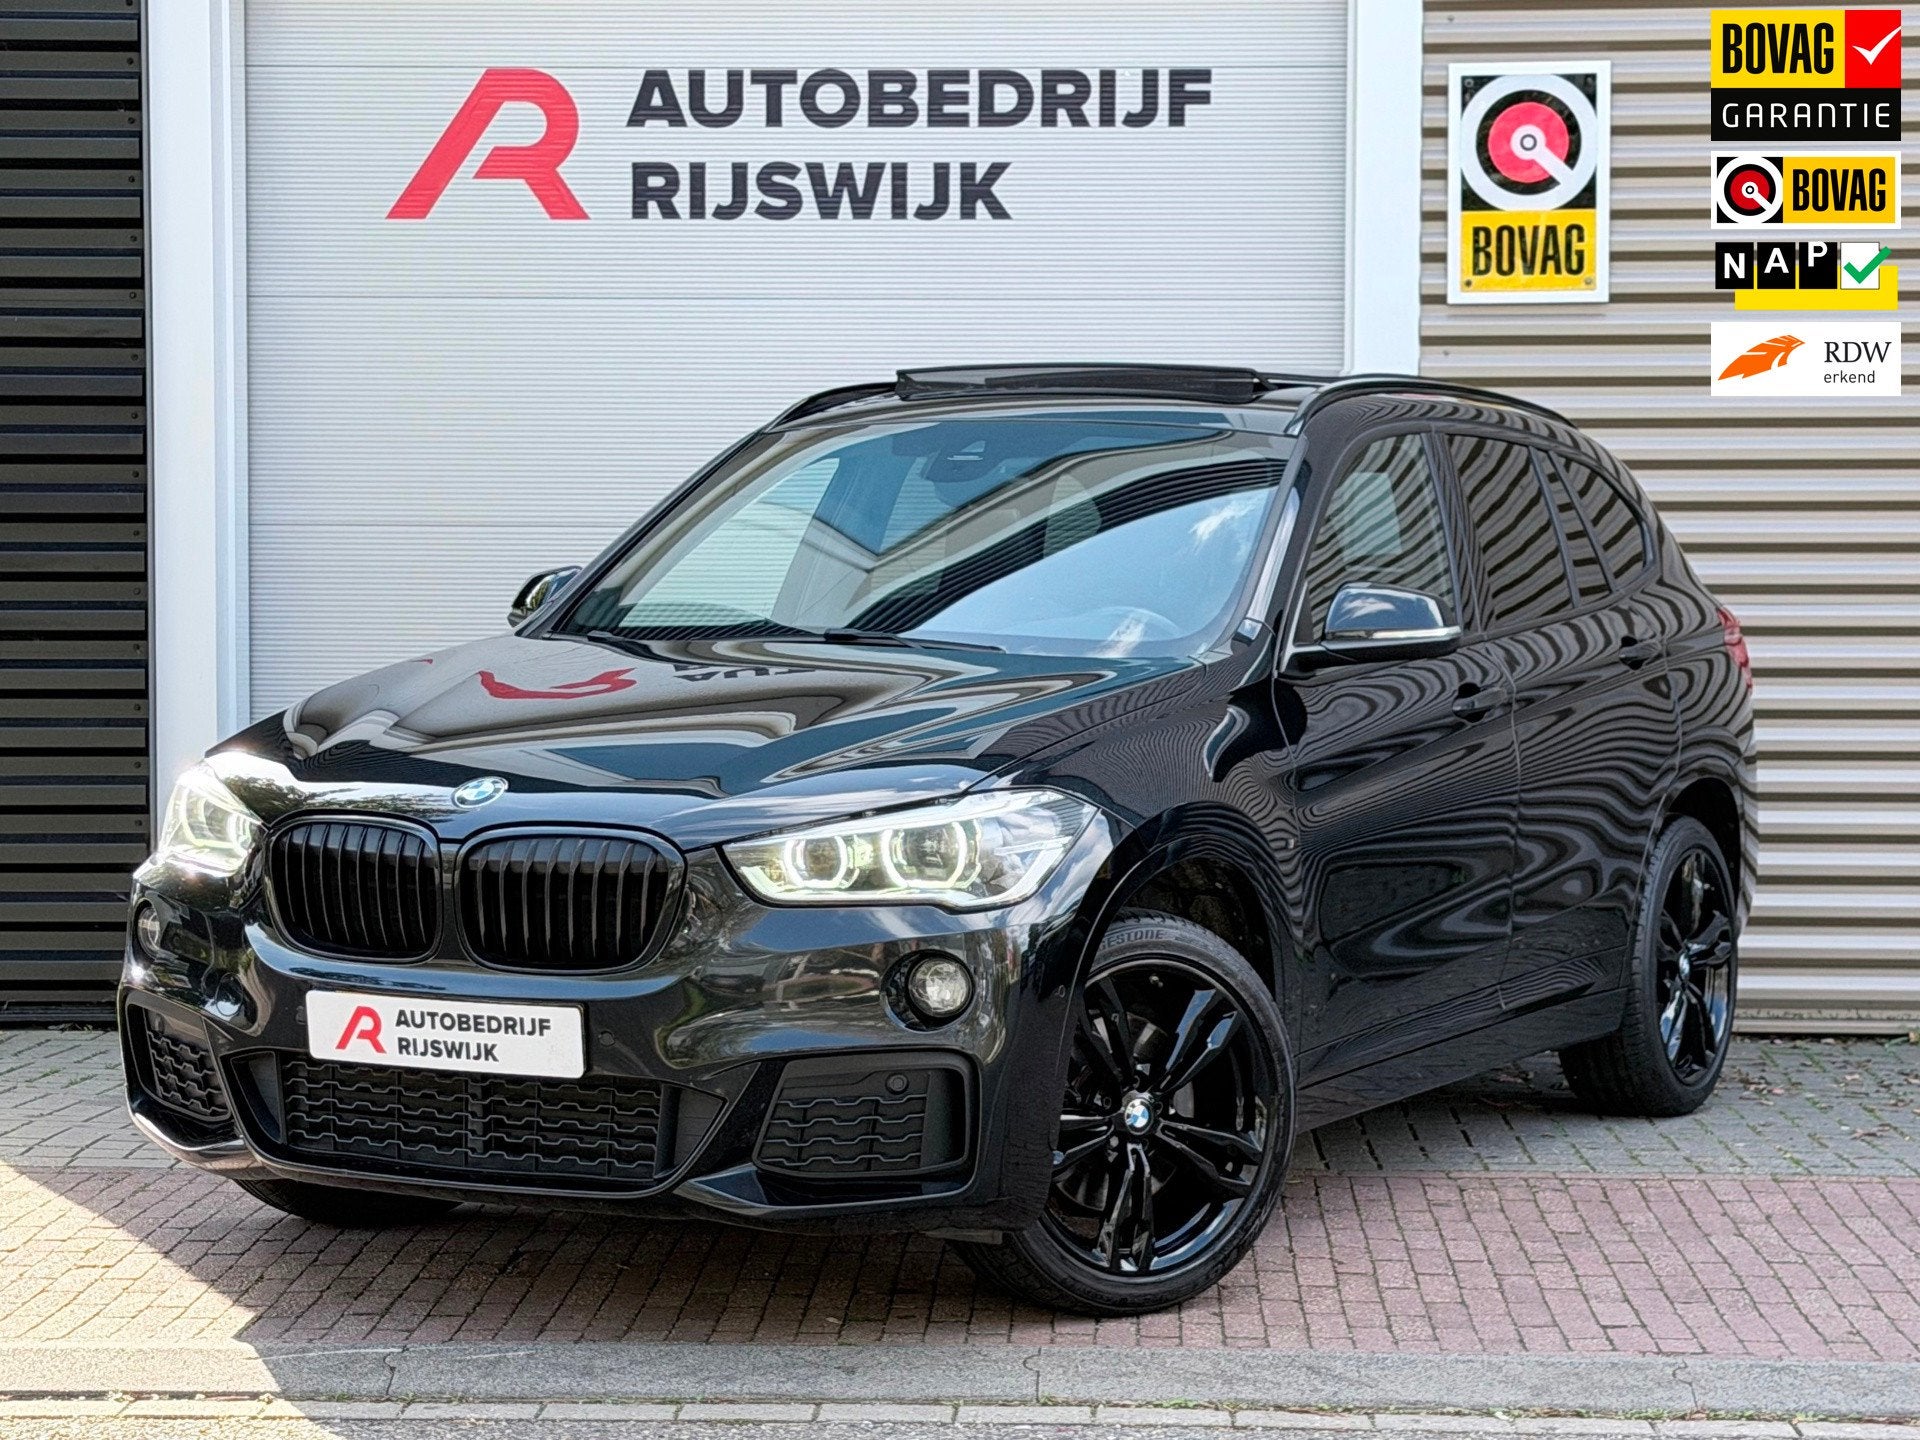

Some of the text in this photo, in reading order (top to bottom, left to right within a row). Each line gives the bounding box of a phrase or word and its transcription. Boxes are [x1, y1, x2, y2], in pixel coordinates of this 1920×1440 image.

[626, 68, 1212, 128] AUTOBEDRIJF
[631, 161, 1012, 220] RIJSWIJK
[1472, 223, 1585, 276] BOVAG
[395, 1009, 551, 1037] AUTOBEDRIJF
[397, 1037, 500, 1062] RIJSWIJK
